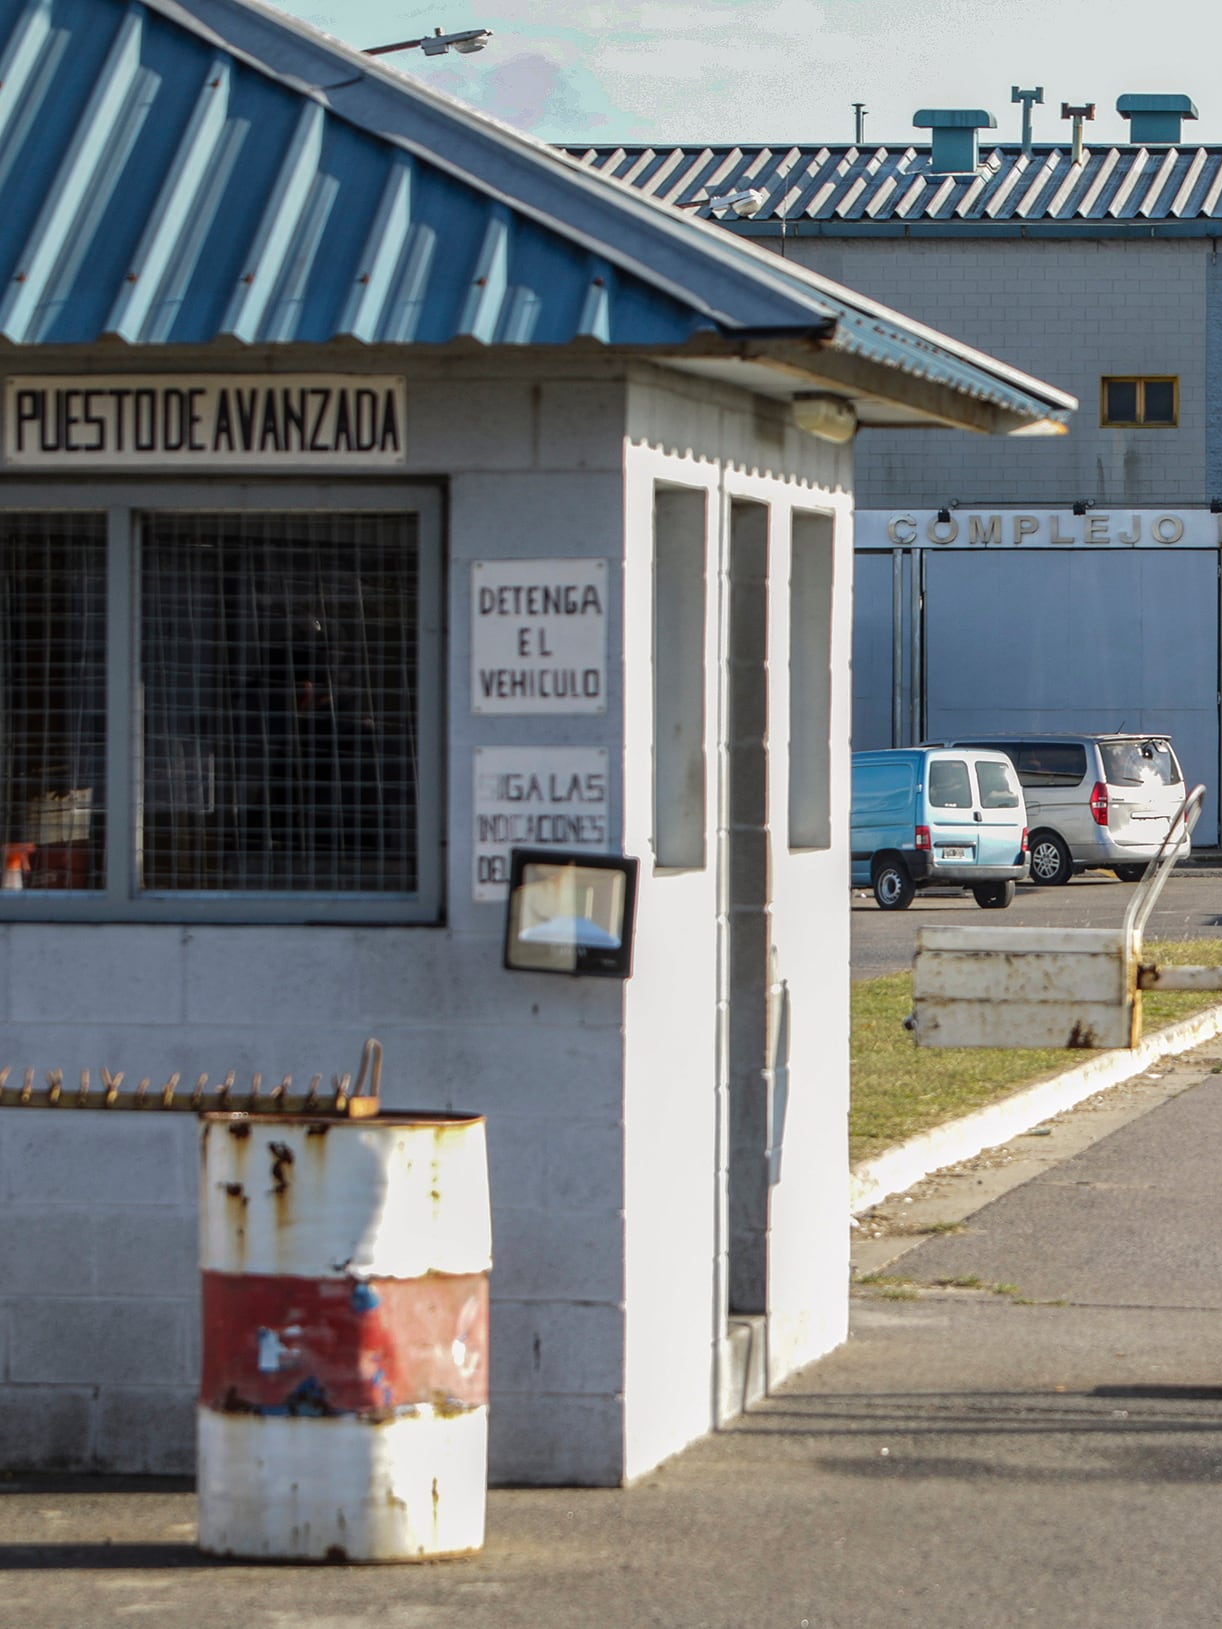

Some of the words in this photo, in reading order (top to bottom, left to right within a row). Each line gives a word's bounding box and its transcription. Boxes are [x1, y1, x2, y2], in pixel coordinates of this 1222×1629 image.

[16, 388, 156, 452] PUESTO
[163, 388, 207, 452] DE
[212, 388, 400, 453] AVANZADA
[887, 513, 1185, 545] COMPLEJO
[479, 584, 603, 615] DETENGA
[517, 626, 553, 657] EL
[478, 668, 601, 699] VEHICULO
[550, 773, 605, 802] LAS
